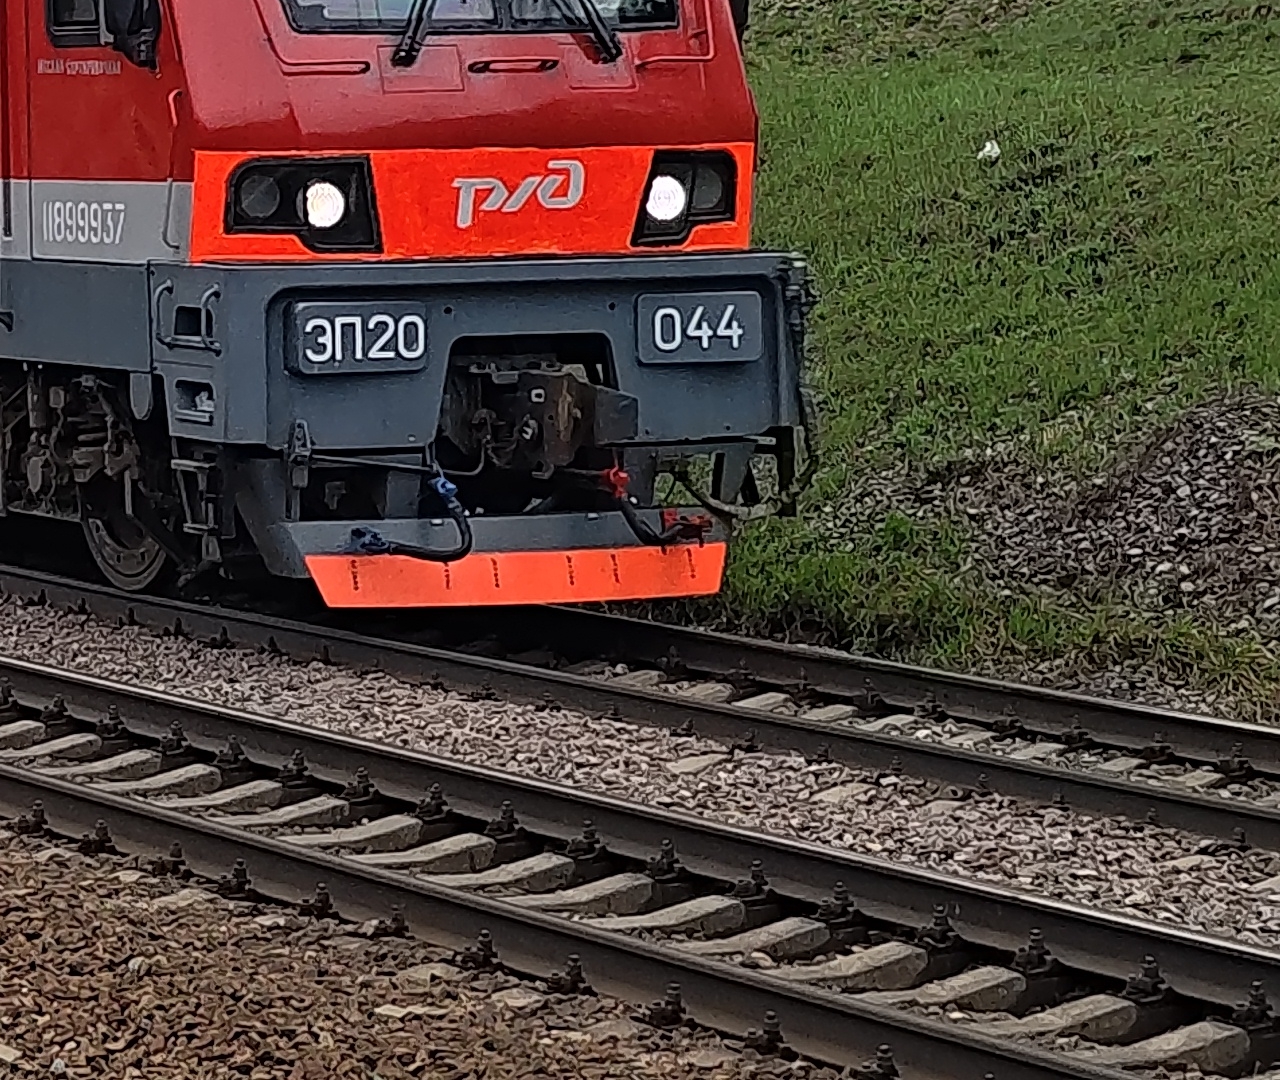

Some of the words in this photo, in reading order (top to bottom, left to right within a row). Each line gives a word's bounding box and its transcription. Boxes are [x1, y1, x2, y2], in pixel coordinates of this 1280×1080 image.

[42, 201, 125, 245] 11899937
[304, 314, 426, 363] ЭП20
[653, 304, 744, 352] 044
